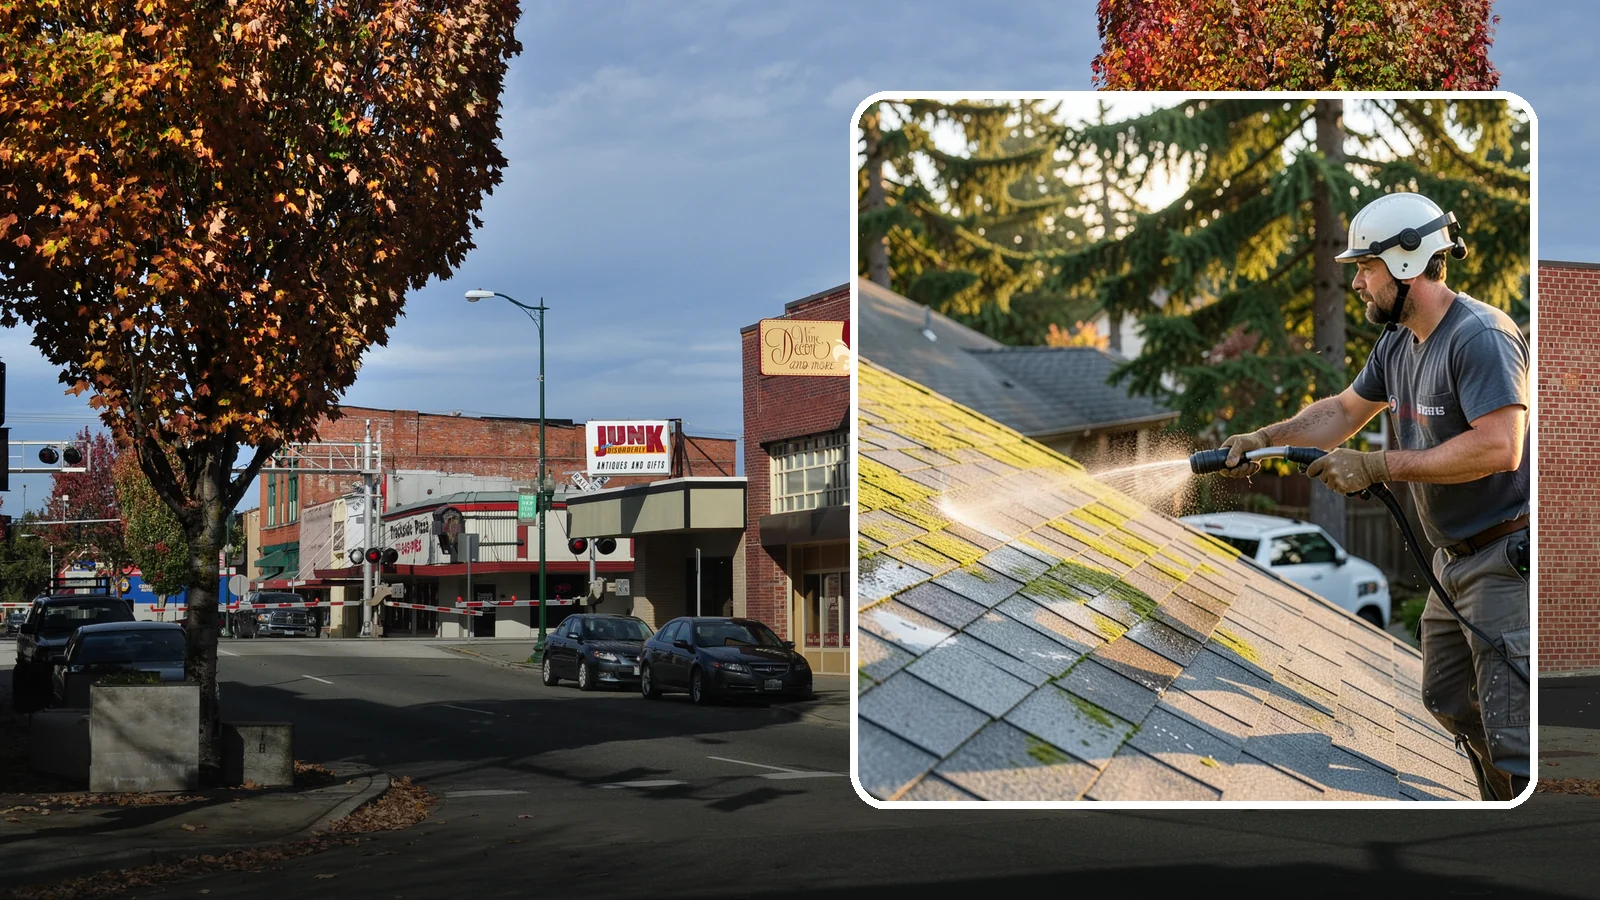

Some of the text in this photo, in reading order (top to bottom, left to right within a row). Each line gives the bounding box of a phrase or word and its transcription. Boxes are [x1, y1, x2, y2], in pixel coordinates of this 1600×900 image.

[595, 425, 665, 457] JUNK
[608, 446, 645, 454] DISORDERLY
[597, 460, 665, 470] ANTIQUES AND GIFTS
[390, 520, 429, 539] Trackside Pizza
